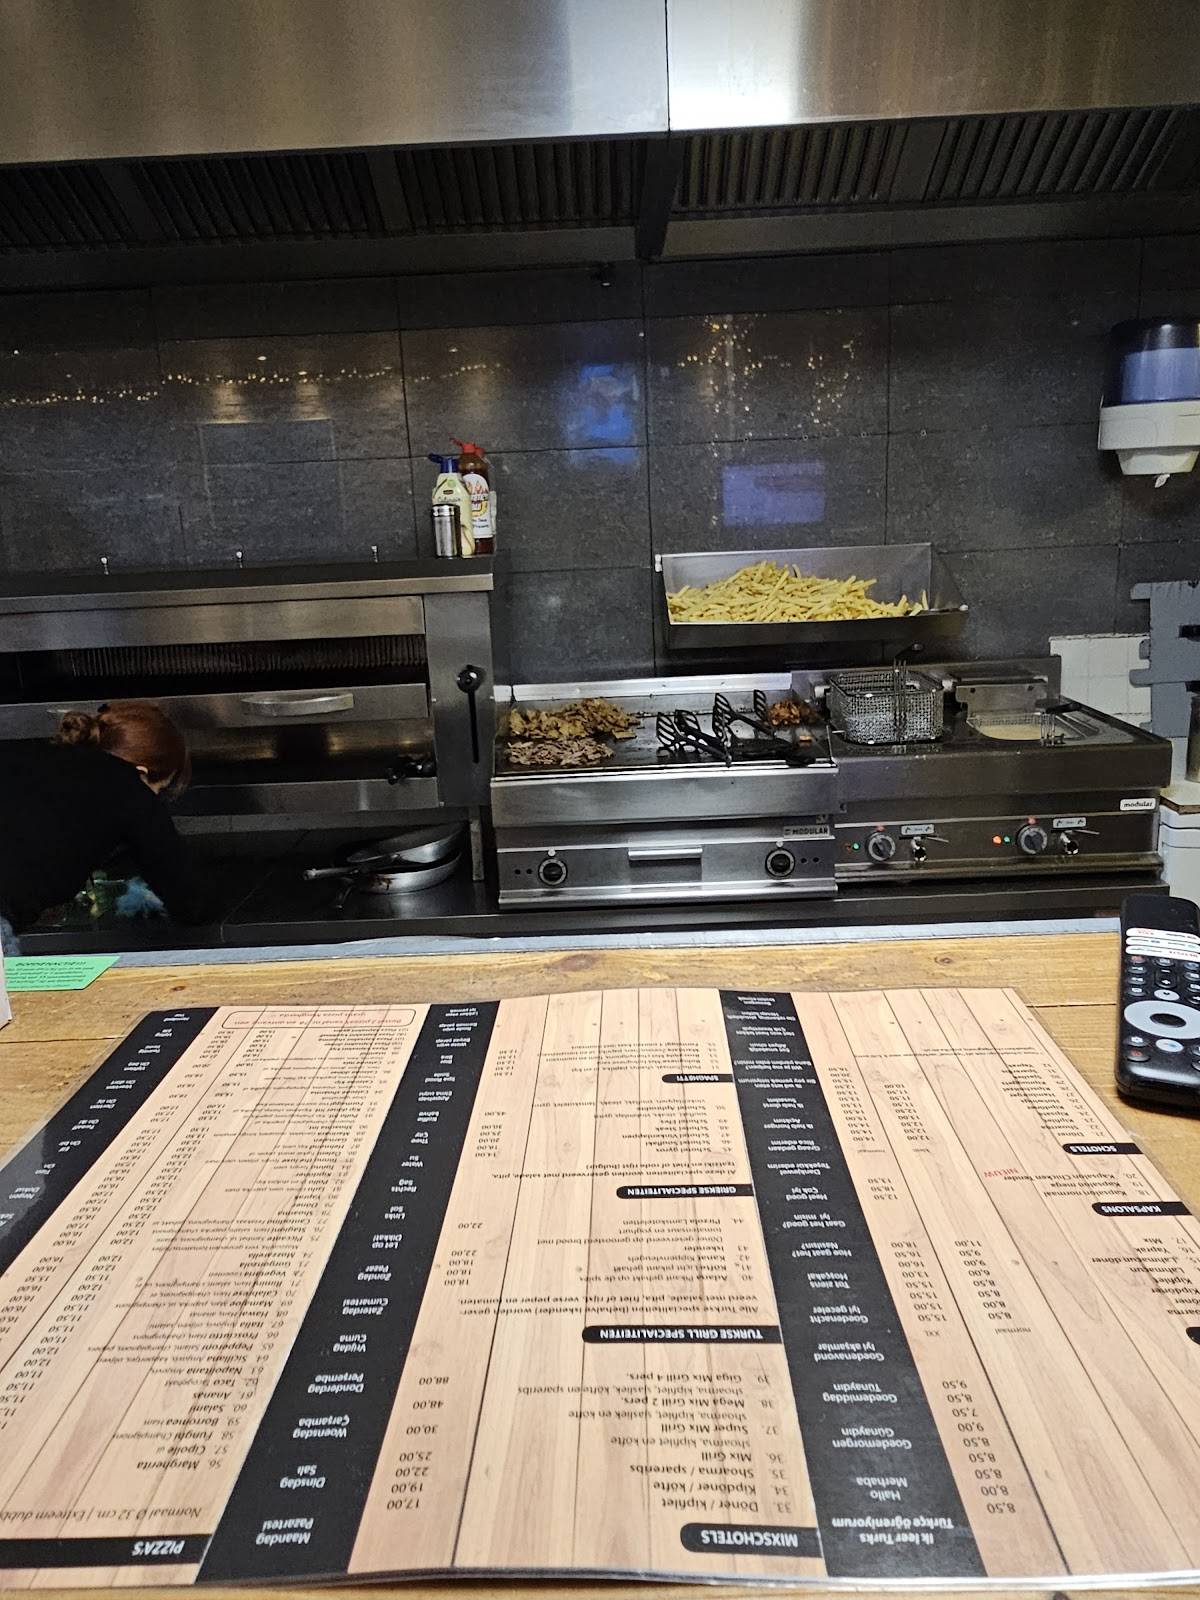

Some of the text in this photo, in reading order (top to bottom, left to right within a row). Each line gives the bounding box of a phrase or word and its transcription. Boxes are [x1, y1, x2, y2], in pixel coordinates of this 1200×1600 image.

[1069, 1145, 1117, 1153] SCHOTELS
[983, 1167, 1019, 1178] NIEUW
[627, 1186, 736, 1196] GRIEKSE SPECIALITEITEN
[1101, 1205, 1162, 1213] KAPSALONS
[833, 1249, 852, 1257] Hoe
[365, 1264, 389, 1273] Pazar
[357, 1272, 392, 1281] Zondag
[835, 1280, 850, 1289] Tot
[342, 1297, 389, 1306] Cumartesi
[342, 1306, 384, 1316] Zaterdag
[813, 1305, 848, 1314] geceler
[809, 1315, 868, 1323] Goedenacht
[339, 1334, 367, 1343] Cuma
[599, 1328, 763, 1339] TURKSE GRILL SPECIALITEITEN
[333, 1342, 367, 1353] Vrijdag
[817, 1341, 861, 1352] akşamlar
[814, 1352, 884, 1362] Goedenavond
[213, 1378, 236, 1387] Taco
[418, 1376, 449, 1386] 88,00
[666, 1373, 689, 1383] Grill
[692, 1373, 713, 1383] Mix
[715, 1372, 742, 1383] Giga
[307, 1382, 364, 1394] Donderdag
[942, 1379, 967, 1389] 9,50
[193, 1391, 231, 1400] Ananas
[823, 1392, 897, 1403] Goedemiddag
[947, 1393, 972, 1403] 8,50
[412, 1399, 444, 1410] 48,00
[621, 1395, 745, 1408] Mega Mix Grill pers.
[188, 1404, 226, 1414] Salami
[952, 1407, 978, 1417] 7,50
[166, 1417, 219, 1427] Borromea
[298, 1414, 350, 1427] Çarşamba
[406, 1424, 438, 1435] 30,00
[661, 1423, 686, 1434] Grill
[689, 1424, 710, 1434] Mix
[714, 1423, 749, 1434] Super
[841, 1426, 894, 1438] Günaydın
[957, 1421, 984, 1432] 9,00
[174, 1429, 213, 1441] Funghi
[293, 1427, 347, 1439] Woensdag
[610, 1436, 639, 1447] köfte
[659, 1436, 697, 1448] kipfilet
[832, 1437, 912, 1449] Goedemorgen
[963, 1436, 990, 1447] 8,50
[167, 1444, 206, 1455] Cipolle
[399, 1451, 432, 1462] 25,00
[701, 1451, 726, 1462] Grill
[729, 1451, 752, 1462] Mix
[968, 1452, 996, 1463] 8,50
[136, 1459, 200, 1470] Margherita
[629, 1464, 687, 1476] spareribs
[395, 1466, 429, 1477] 22,00
[699, 1466, 754, 1478] Shoarma
[974, 1468, 1002, 1479] 8,50
[279, 1476, 326, 1490] Dinsdag
[391, 1482, 424, 1493] 19,00
[653, 1481, 686, 1493] köfte
[856, 1476, 908, 1488] Merhaba
[697, 1481, 756, 1495] Kipdöner
[980, 1485, 1009, 1496] 8,00
[870, 1489, 901, 1500] Hallo
[386, 1498, 420, 1510] 17,00
[661, 1498, 792, 1513] 33. Döner kipfilet
[987, 1502, 1016, 1514] 8,50
[35, 1507, 202, 1521] Normaal 32 Extreem
[261, 1517, 314, 1531] Pazartesi
[832, 1515, 954, 1529] Türkçe öğreniyorum
[256, 1531, 311, 1547] Maandag
[700, 1529, 798, 1548] MIXSCHOTELS
[860, 1532, 934, 1544] Ik leer Turks
[131, 1540, 185, 1556] PIZZA'S
